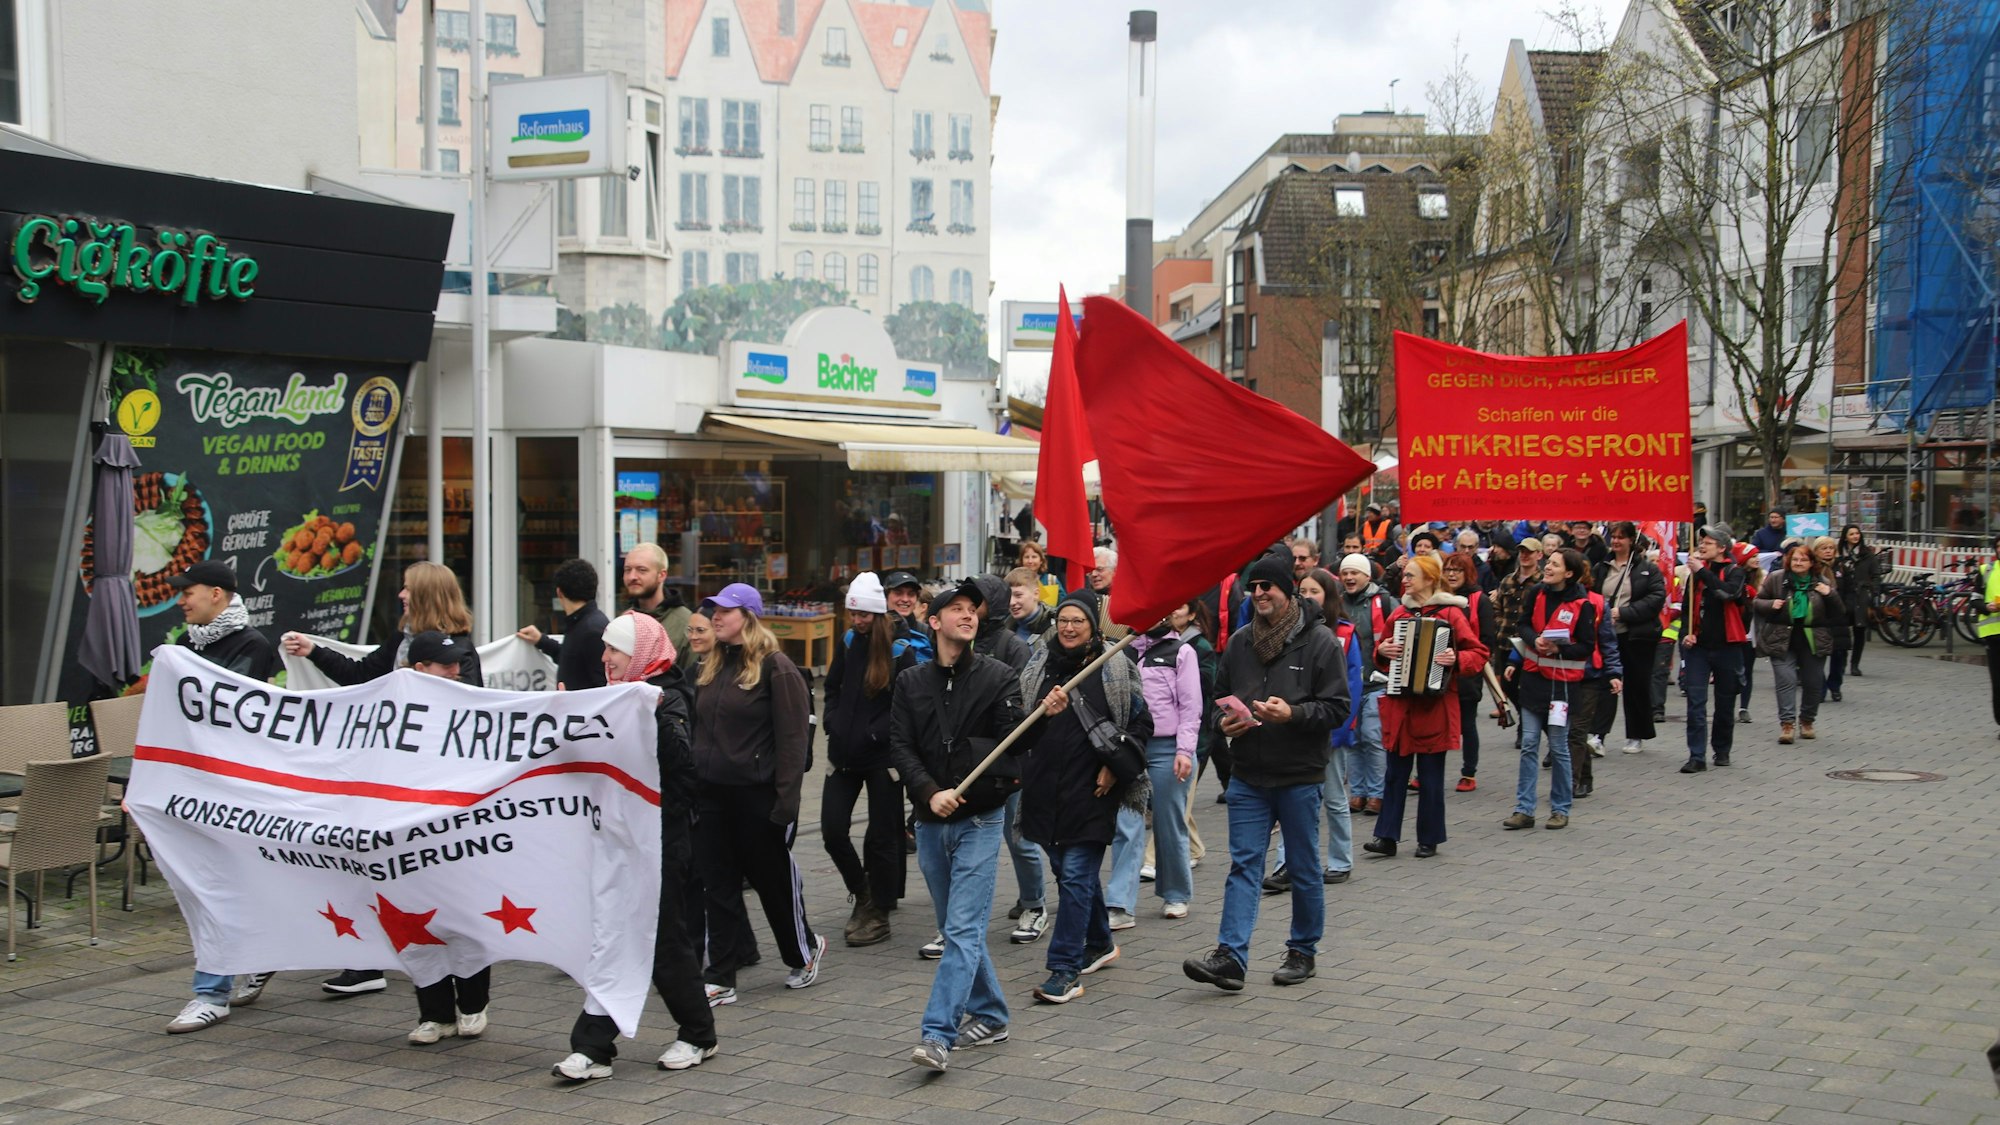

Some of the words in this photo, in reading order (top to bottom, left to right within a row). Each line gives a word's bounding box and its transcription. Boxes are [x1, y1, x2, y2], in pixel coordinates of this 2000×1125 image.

[520, 119, 584, 139] Reformhaus
[15, 218, 259, 304] Çiğköfte
[1024, 317, 1056, 330] Reform
[748, 358, 785, 377] Reformhaus
[817, 353, 877, 392] Bacher
[1428, 373, 1494, 388] GEGEN
[1500, 373, 1553, 390] DICH,
[1477, 406, 1554, 422] Schaffen
[1560, 407, 1586, 422] wir
[1592, 406, 1618, 421] die
[202, 434, 271, 455] VEGAN
[274, 431, 326, 452] FOOD
[353, 447, 384, 461] TASTE
[1409, 432, 1685, 458] ANTIKRIEGSFRONT
[217, 457, 232, 476] &
[235, 453, 302, 475] DRINKS
[1408, 470, 1446, 491] der
[1453, 468, 1569, 491] Arbeiter
[1577, 473, 1593, 489] +
[1601, 468, 1691, 492] Völker
[222, 530, 269, 552] GERICHTE
[178, 676, 333, 746] GEGEN
[337, 700, 429, 753] IHRE
[165, 794, 312, 843] KONSEQUENT
[312, 824, 394, 852] GEGEN
[406, 796, 601, 842] AUFRÜSTUNG
[258, 846, 278, 863] &
[276, 832, 514, 881] MILITARISIERUNG
